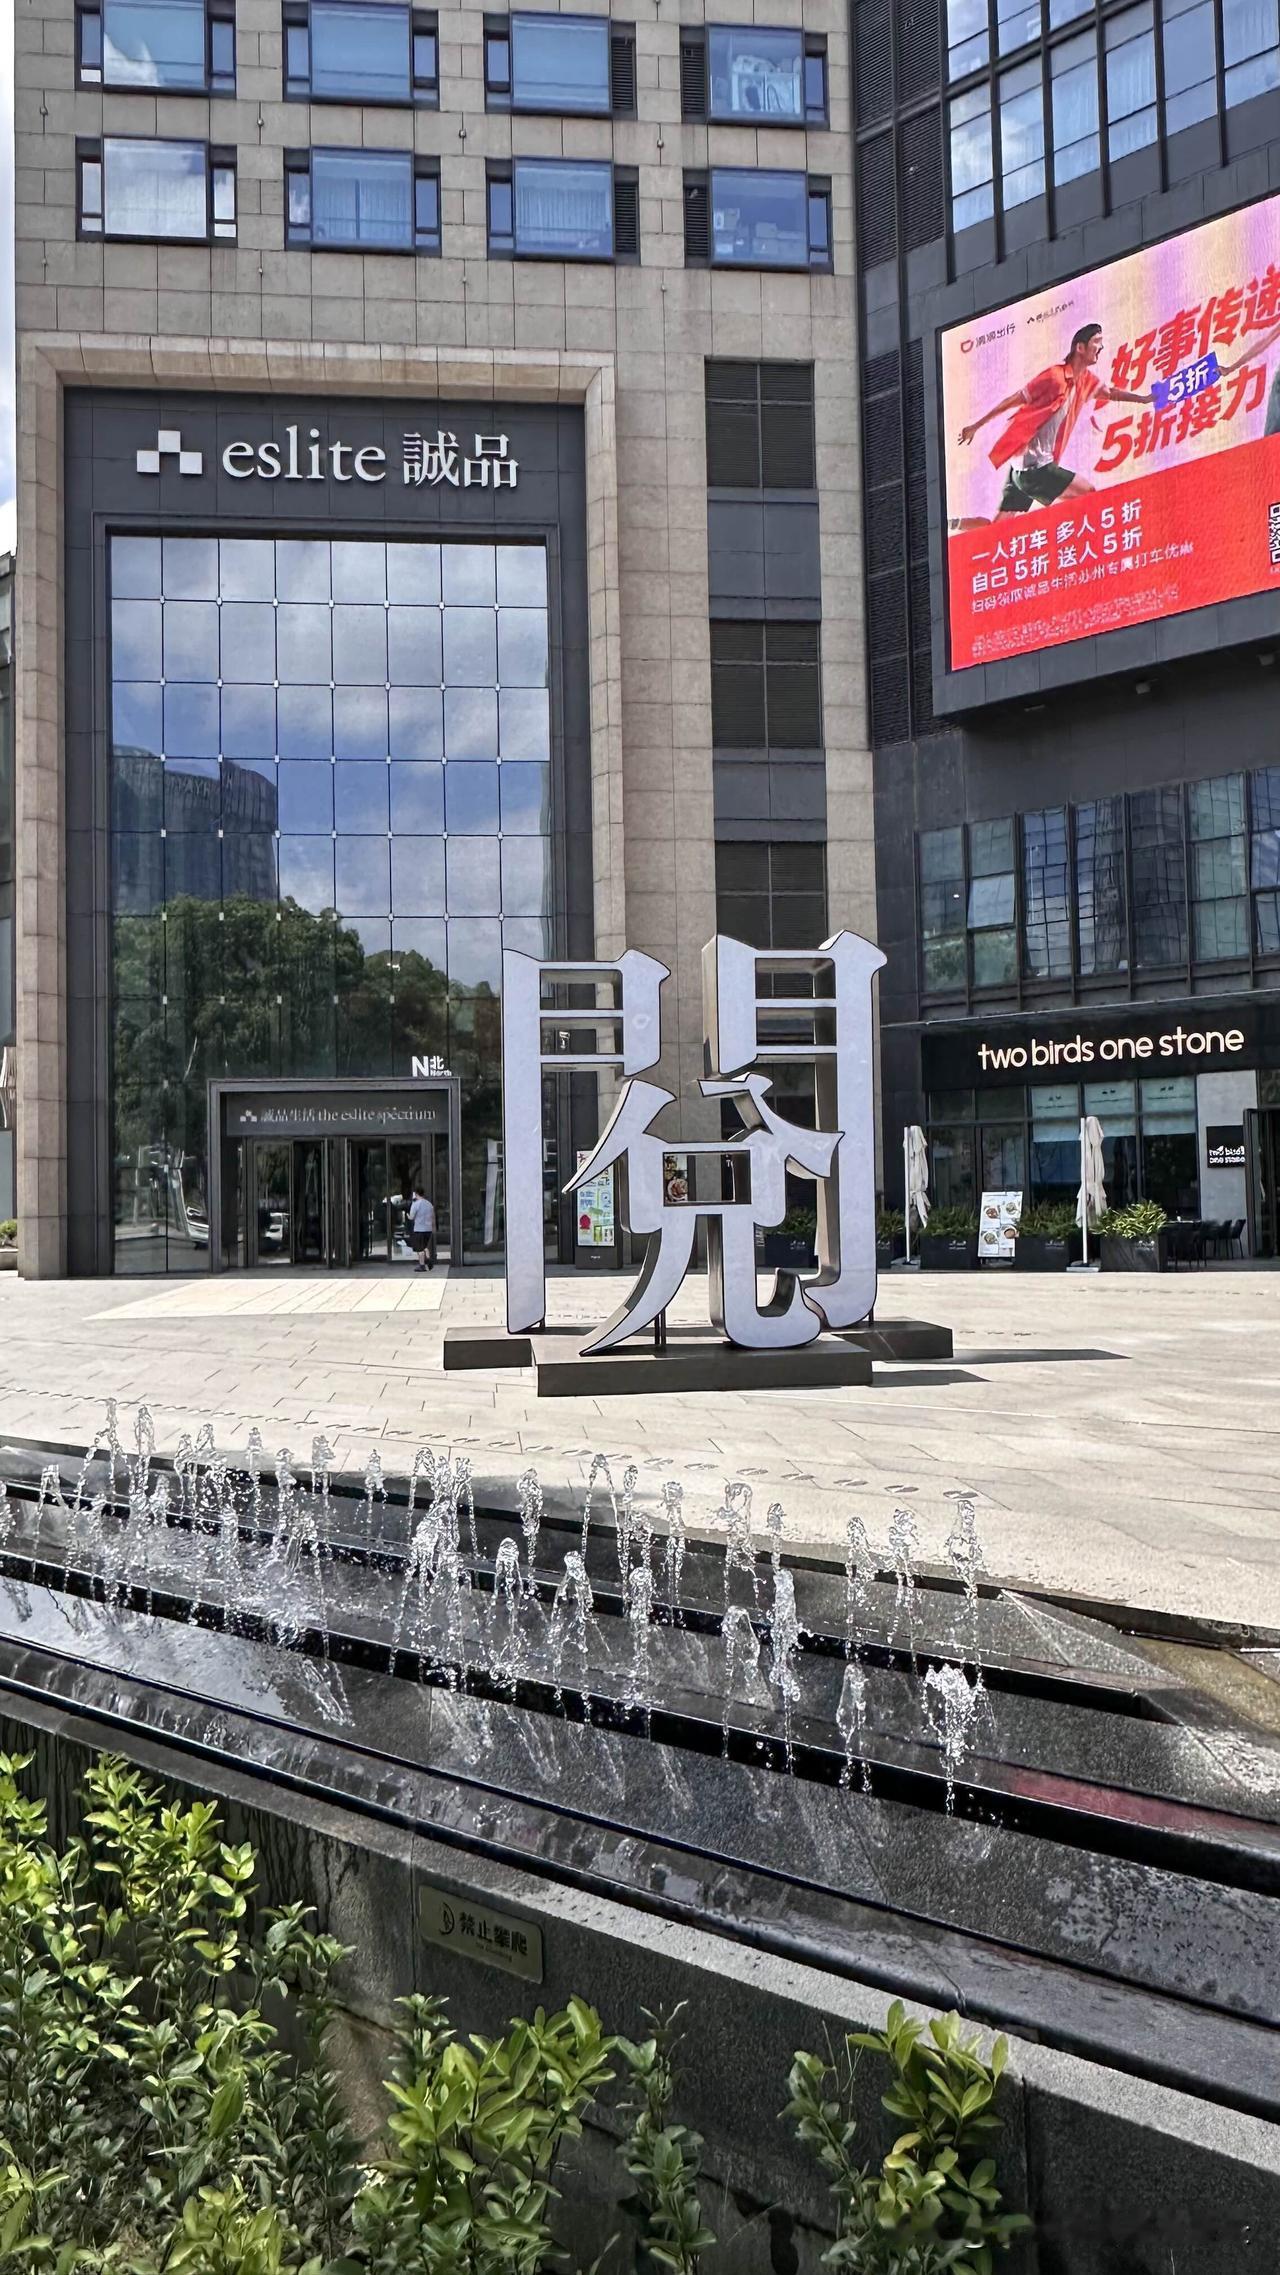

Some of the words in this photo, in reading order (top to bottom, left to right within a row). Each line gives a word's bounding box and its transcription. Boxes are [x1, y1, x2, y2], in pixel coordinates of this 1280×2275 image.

[1111, 263, 1280, 392] 好事传递
[1167, 360, 1210, 401] 5折
[1094, 363, 1268, 473] 5折接力
[222, 424, 387, 482] eslite
[402, 429, 519, 489] 誠品
[971, 528, 1048, 564] 一人打车
[1056, 498, 1143, 544] 多人5折
[971, 553, 1049, 595] 自己5折
[1057, 526, 1143, 571] 送人5折
[411, 1055, 429, 1077] N
[978, 1043, 1028, 1071] two
[1031, 1034, 1094, 1066] birds
[1099, 1036, 1154, 1061] one
[1159, 1026, 1245, 1056] stone
[318, 1108, 338, 1121] the
